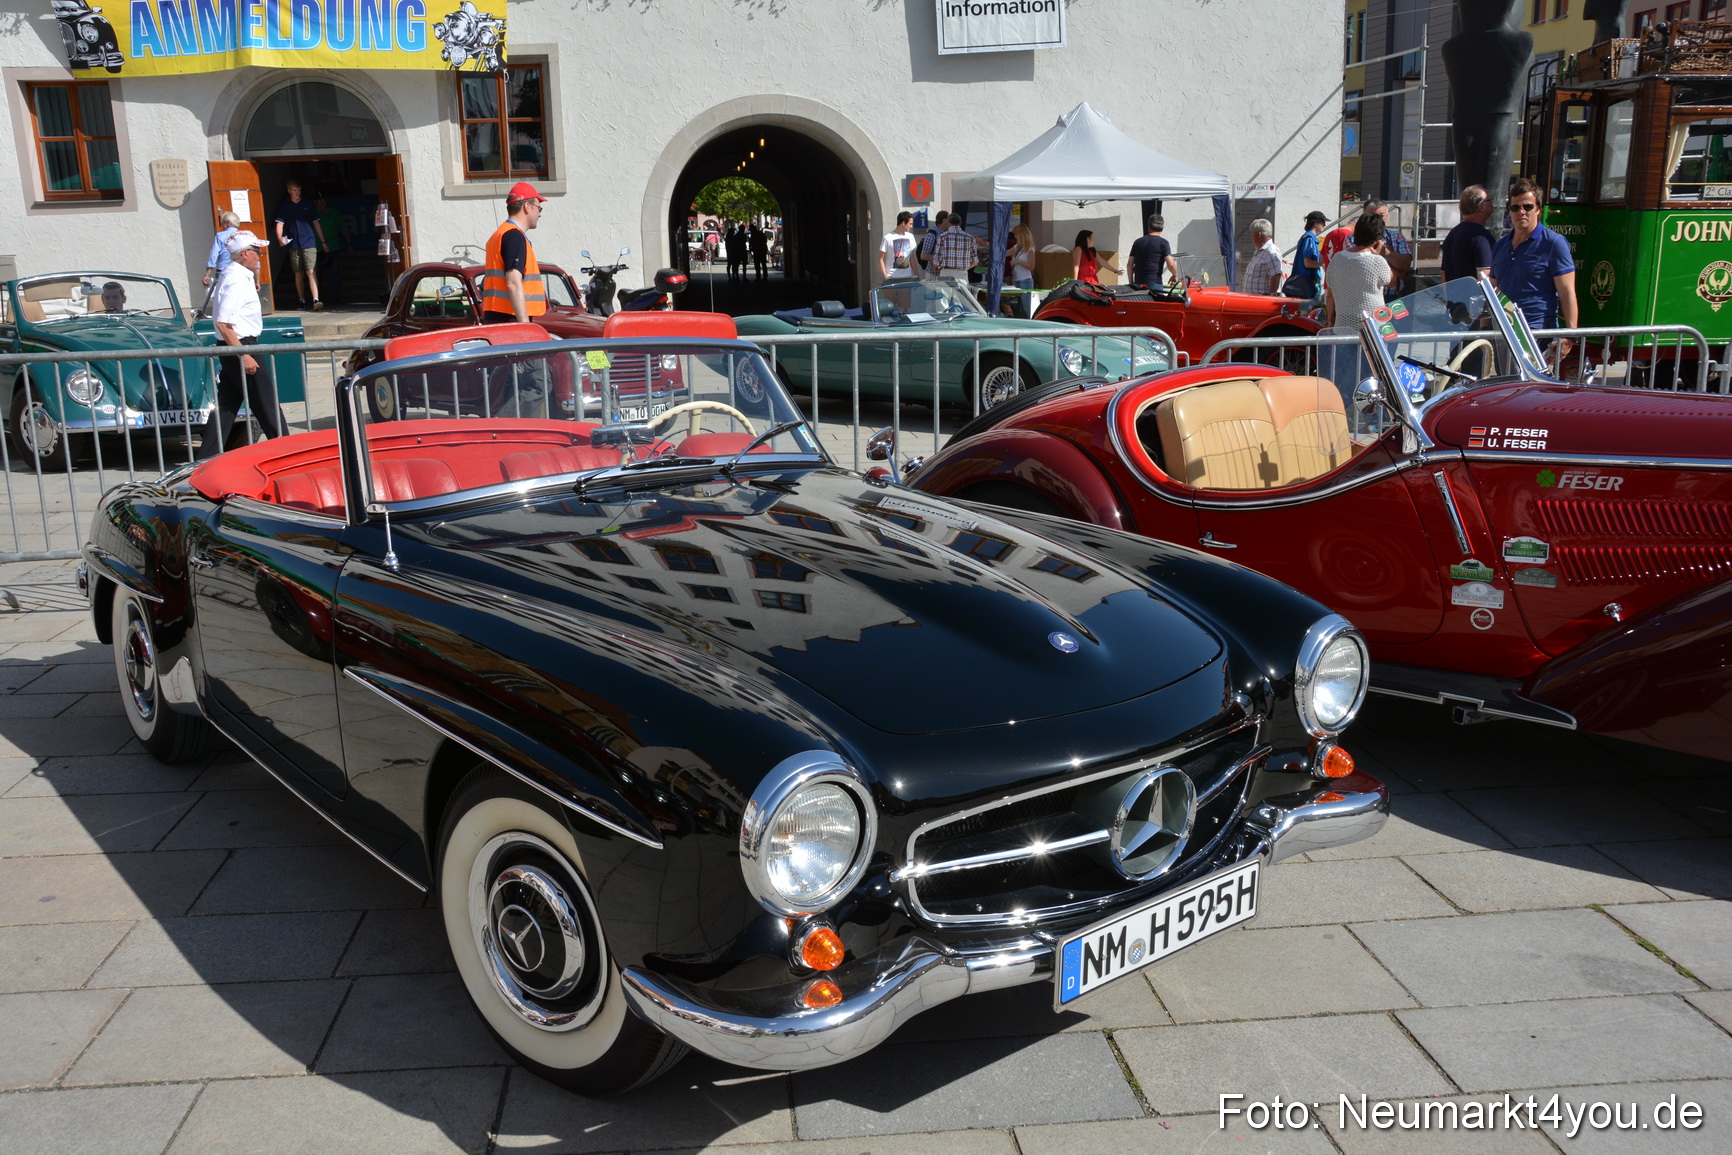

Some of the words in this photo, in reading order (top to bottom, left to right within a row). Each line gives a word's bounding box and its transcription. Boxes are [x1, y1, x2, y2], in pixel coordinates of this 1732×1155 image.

[945, 0, 1056, 17] Information
[130, 0, 427, 58] ANMELDUNG
[1717, 187, 1732, 197] Cla
[143, 413, 152, 425] N
[159, 411, 177, 424] VW
[620, 407, 631, 420] NM
[1490, 427, 1501, 436] P.
[1505, 427, 1549, 438] FESER
[1487, 438, 1499, 447] U.
[1503, 439, 1547, 450] FESER
[1557, 474, 1624, 491] FESER
[1506, 548, 1526, 557] SACHSEN
[1526, 549, 1545, 557] CLASSIC
[1067, 975, 1075, 990] D
[1082, 925, 1128, 987] NM
[1149, 906, 1171, 956] H
[1177, 870, 1257, 942] 595H
